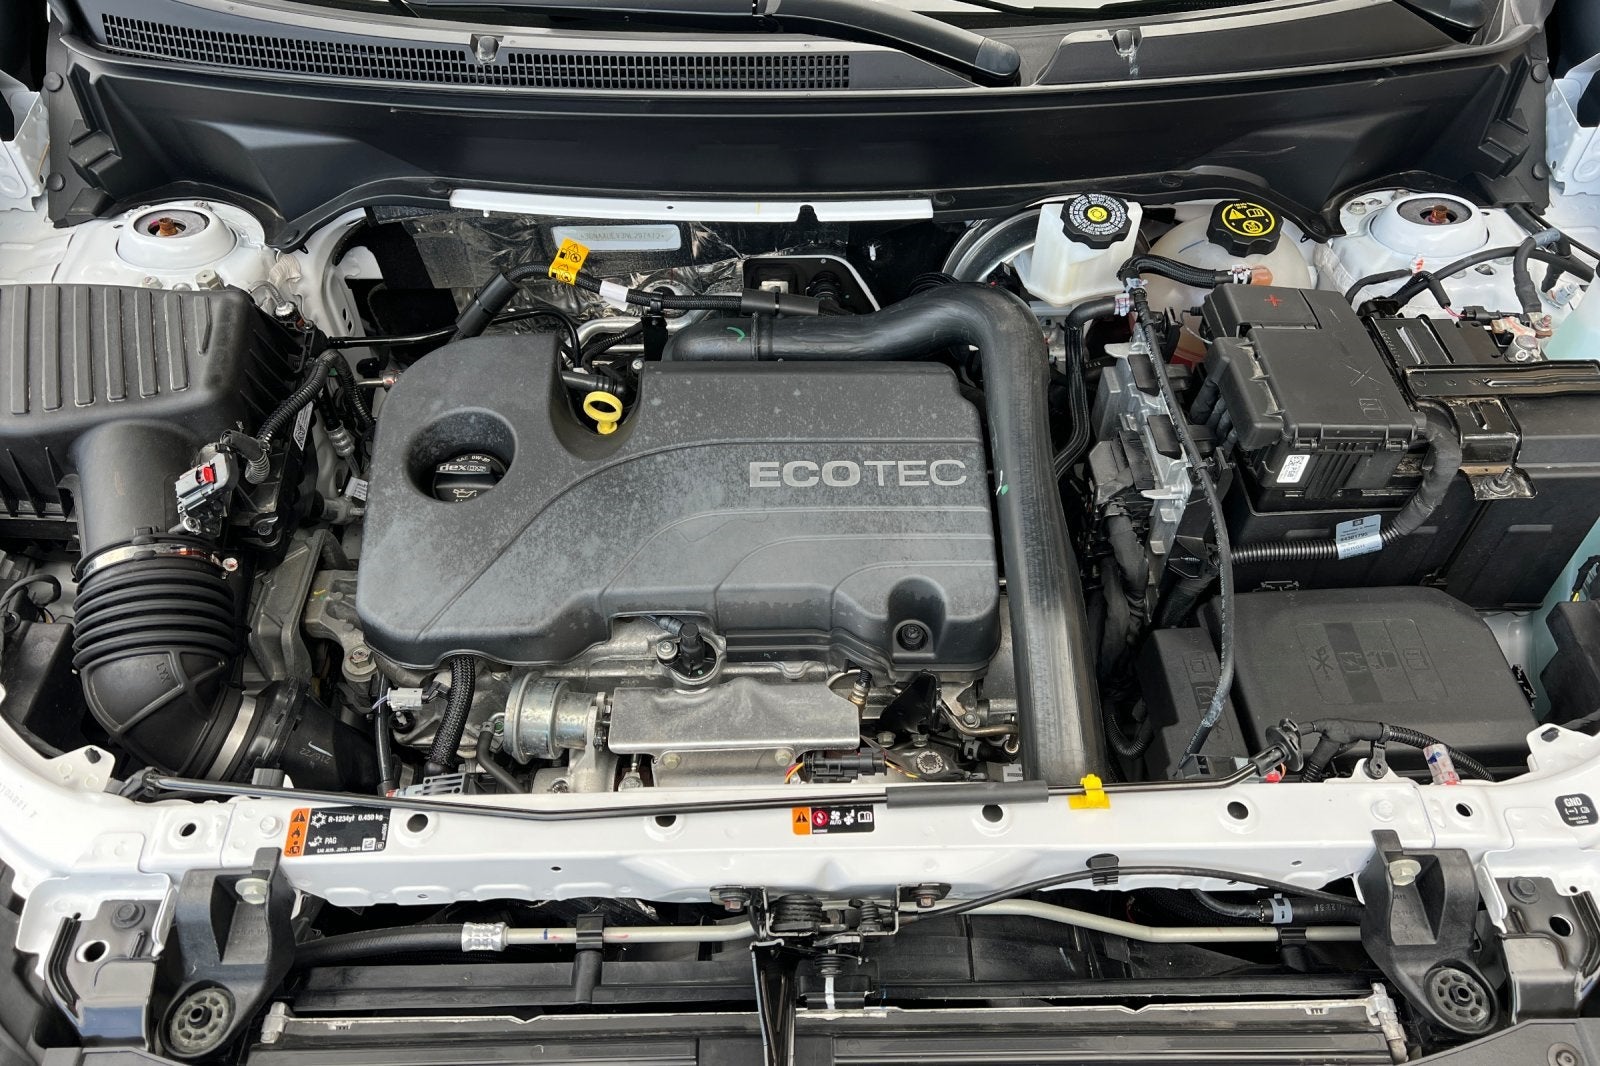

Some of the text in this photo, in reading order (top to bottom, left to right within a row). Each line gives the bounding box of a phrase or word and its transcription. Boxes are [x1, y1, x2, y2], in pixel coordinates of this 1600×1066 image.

[750, 459, 967, 487] ECOTEC
[1564, 797, 1582, 807] GND
[375, 813, 383, 821] kg
